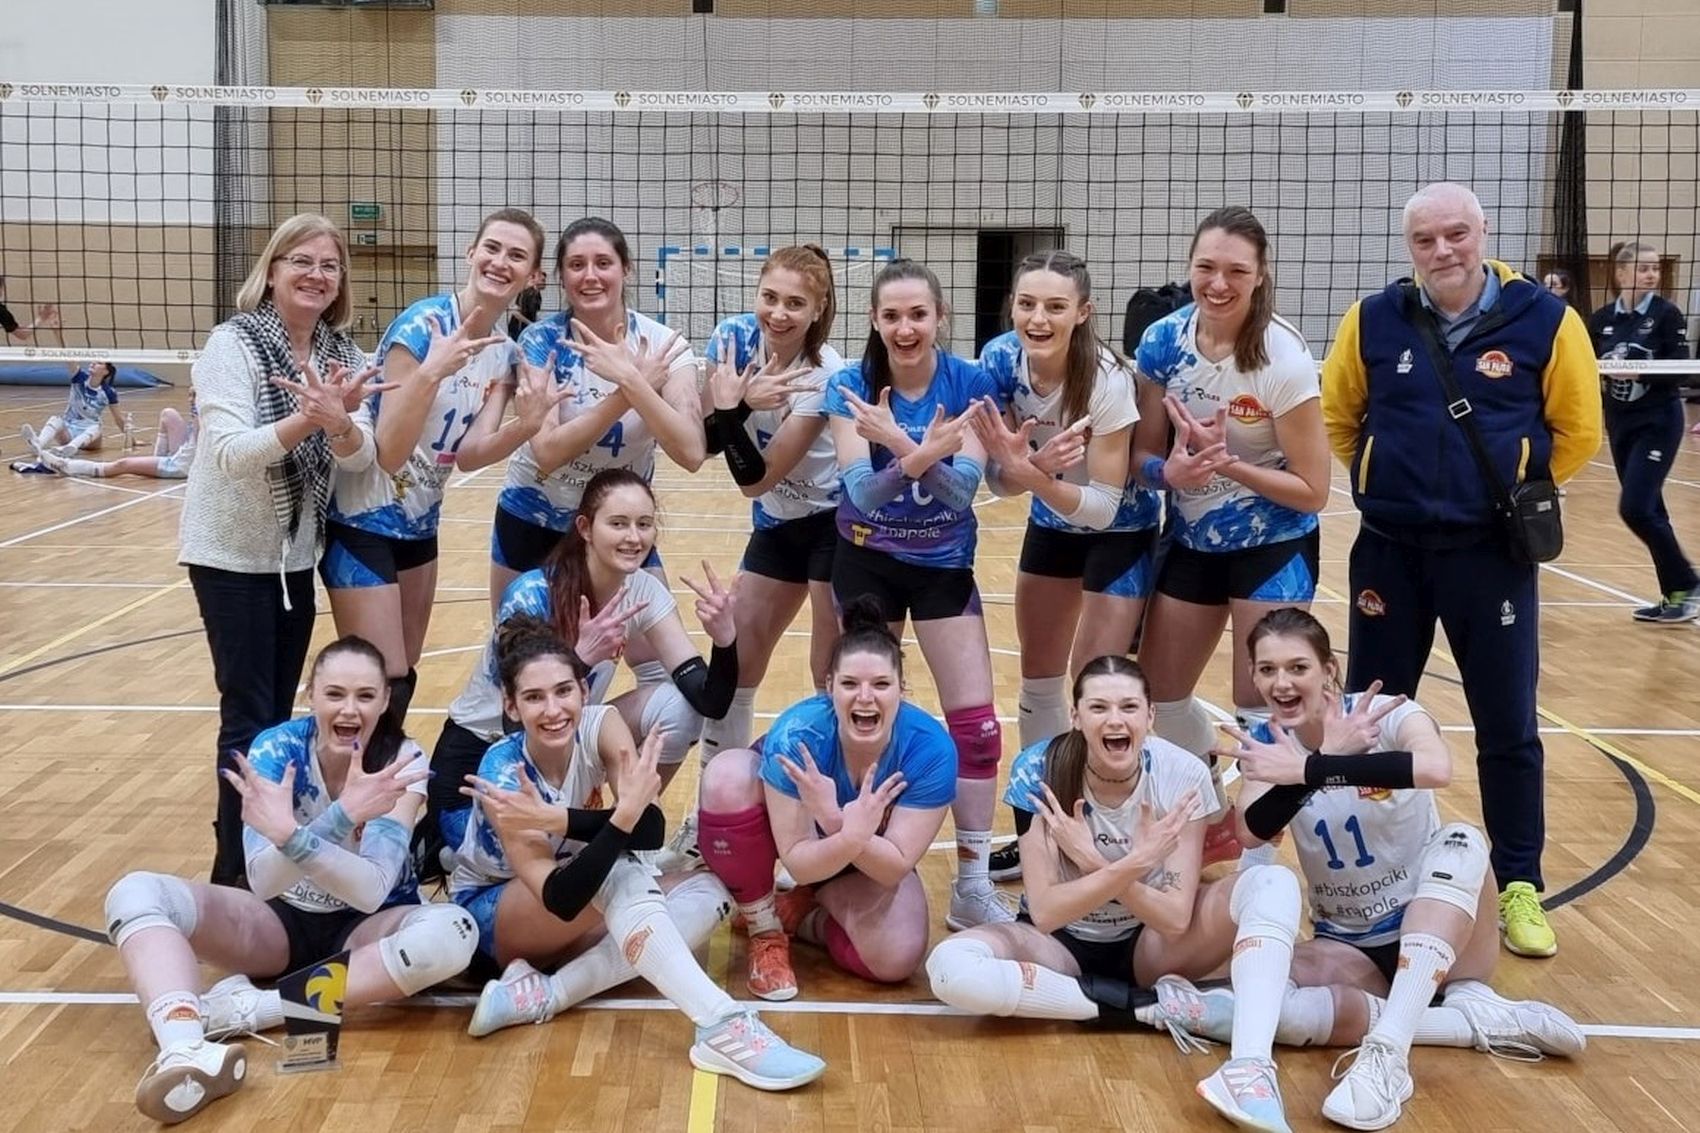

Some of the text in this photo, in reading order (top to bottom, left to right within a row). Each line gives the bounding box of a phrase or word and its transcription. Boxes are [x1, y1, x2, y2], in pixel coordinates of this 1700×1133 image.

[20, 85, 121, 98] SOLNEMIASTO
[176, 87, 276, 100] SOLNEMIASTO
[331, 90, 431, 102] SOLNEMIASTO
[1583, 91, 1687, 104] SOLNEMIASTO
[485, 92, 585, 104] SOLNEMIASTO
[638, 93, 738, 105] SOLNEMIASTO
[793, 95, 893, 106] SOLNEMIASTO
[948, 95, 1048, 106] SOLNEMIASTO
[1104, 94, 1205, 105] SOLNEMIASTO
[1261, 93, 1365, 104] SOLNEMIASTO
[1422, 92, 1525, 104] SOLNEMIASTO
[1314, 815, 1376, 870] 11
[1314, 865, 1409, 898] #biszkopciki
